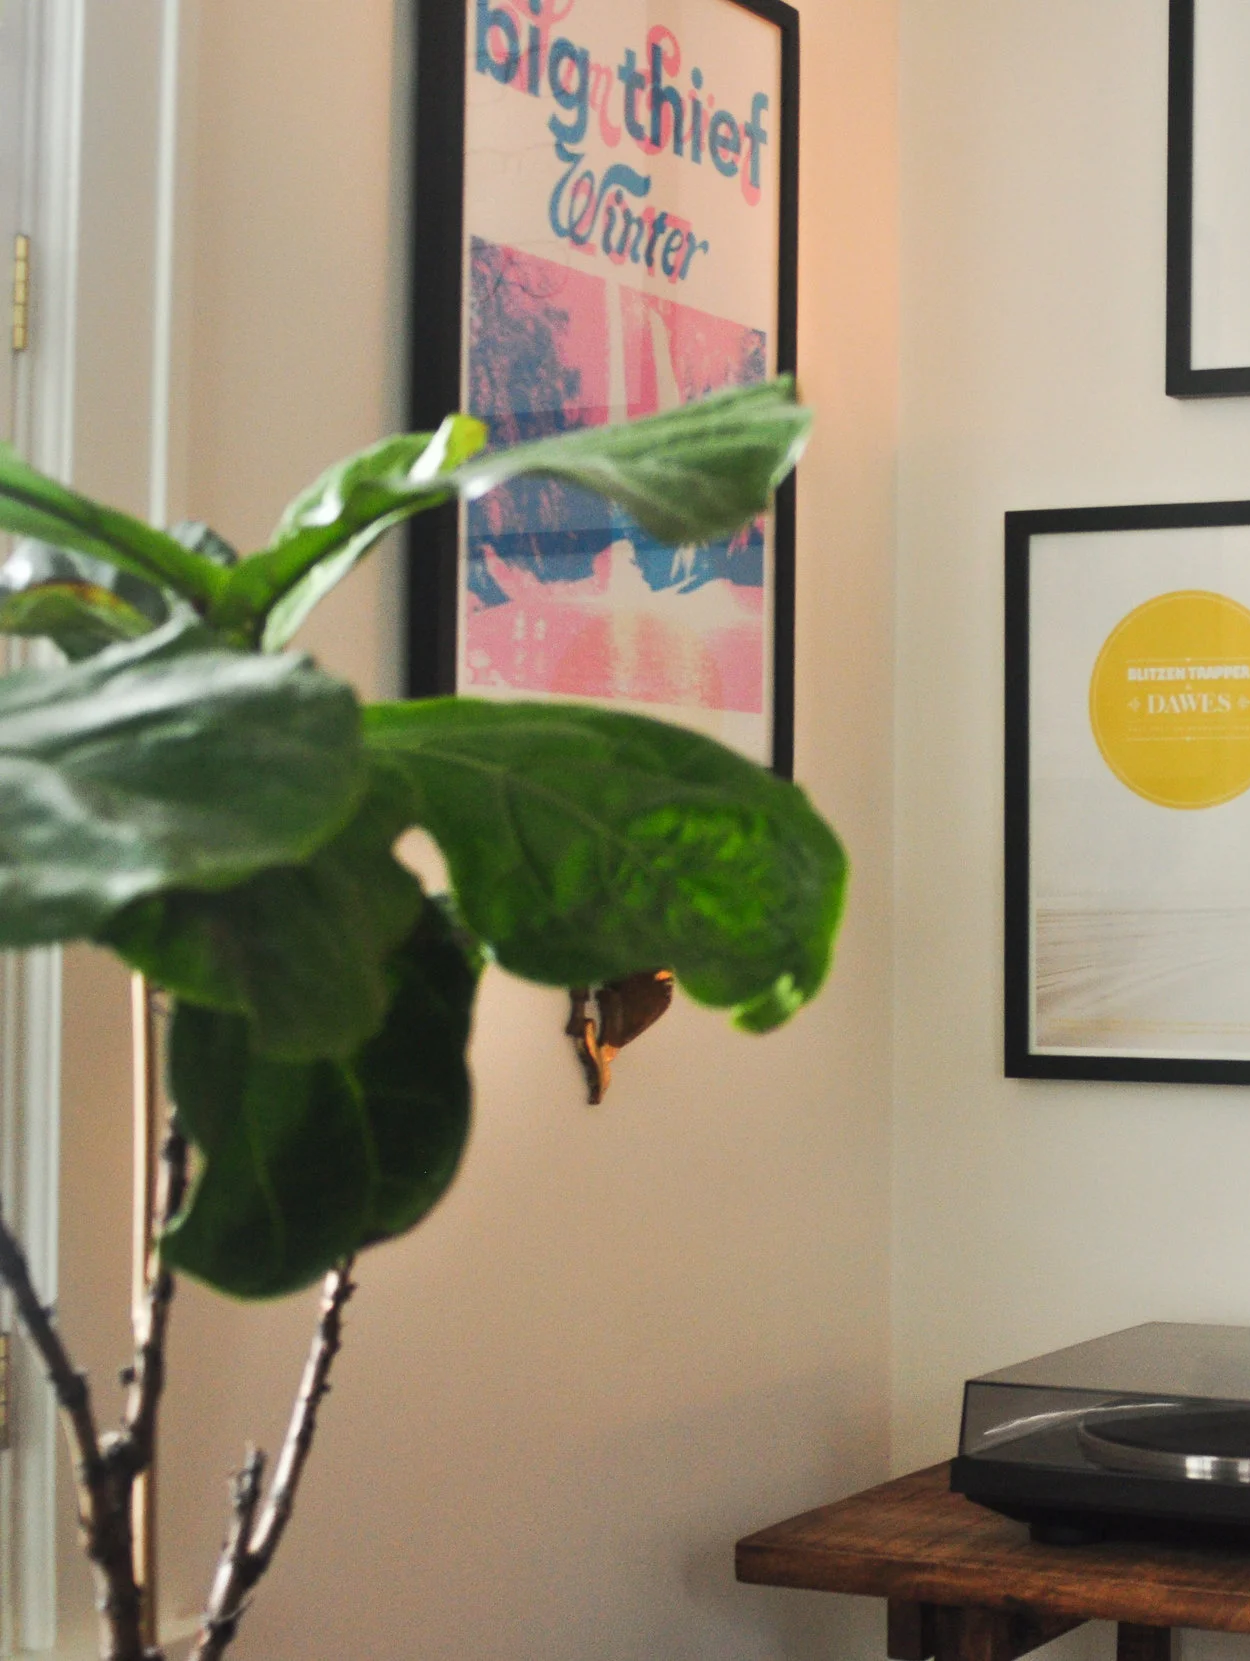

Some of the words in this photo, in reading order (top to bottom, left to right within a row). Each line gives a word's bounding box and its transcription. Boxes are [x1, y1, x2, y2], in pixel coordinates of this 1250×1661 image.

[474, 0, 591, 146] big
[617, 42, 769, 190] thief
[548, 142, 709, 281] Winter
[1127, 667, 1186, 680] BLITZEN
[1148, 693, 1232, 714] DAWES
